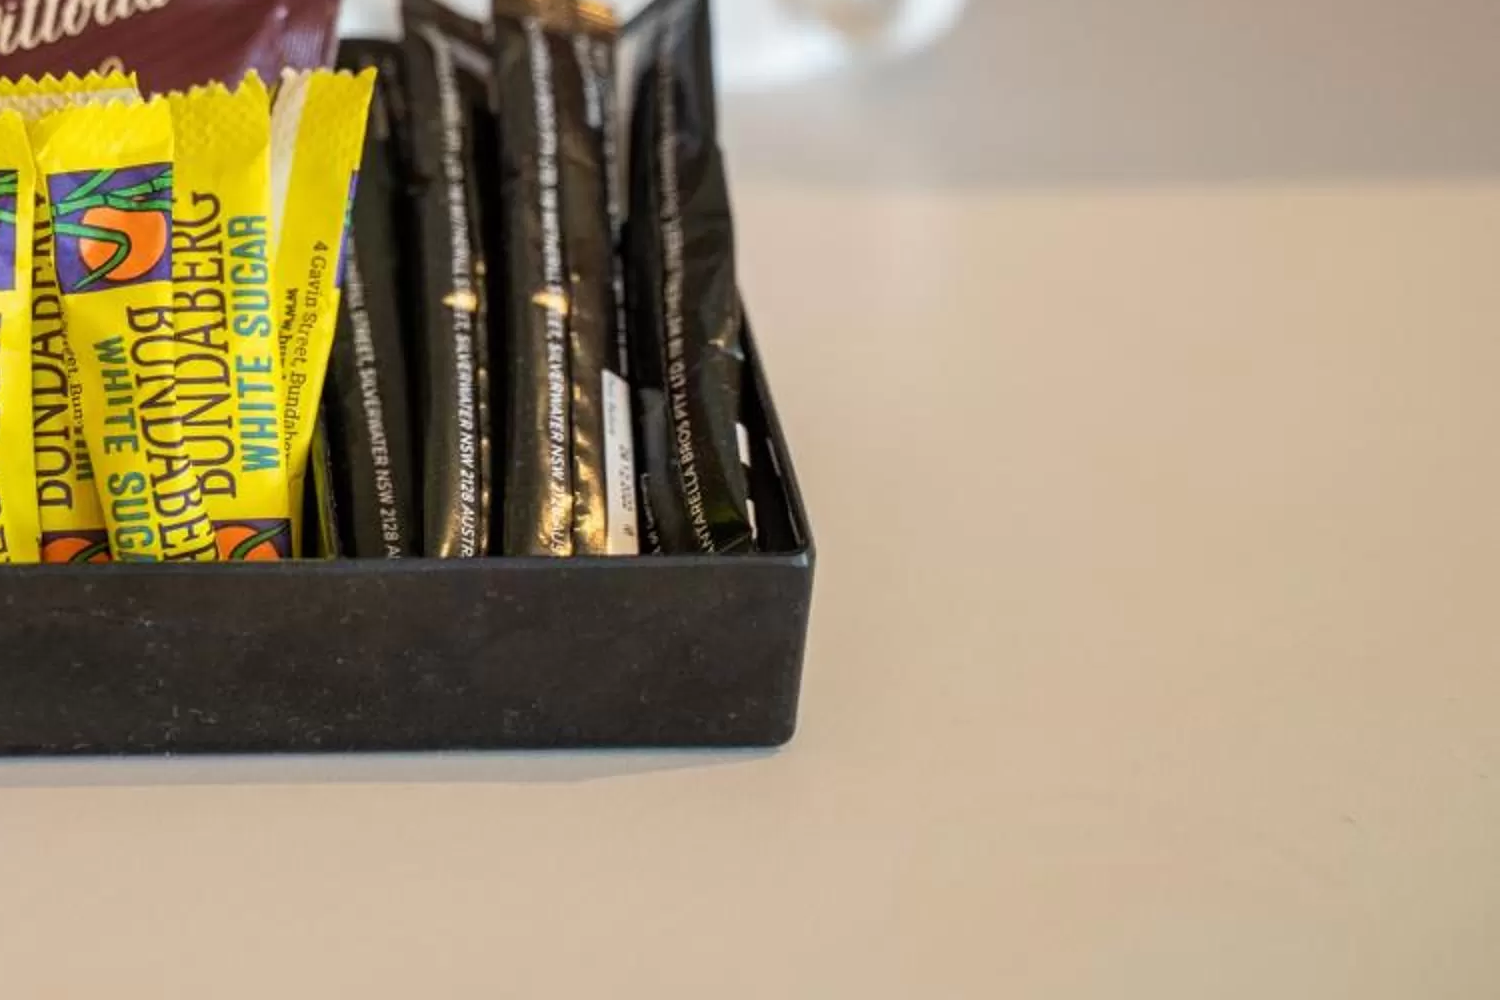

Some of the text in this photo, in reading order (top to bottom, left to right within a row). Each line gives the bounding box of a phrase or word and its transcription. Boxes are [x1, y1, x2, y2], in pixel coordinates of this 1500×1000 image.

[32, 192, 73, 509] BUNDAB
[172, 191, 236, 499] BUNDABERG
[228, 214, 280, 473] WHITE SUGAR
[283, 240, 329, 468] 4 Gavin Street, Bundabe
[92, 336, 140, 456] WHITE
[358, 367, 390, 466] SILVERWATER
[375, 468, 395, 504] NSW
[459, 431, 475, 468] NSW
[459, 469, 476, 503] 2128
[550, 444, 566, 481] NSW
[379, 507, 400, 541] 2128
